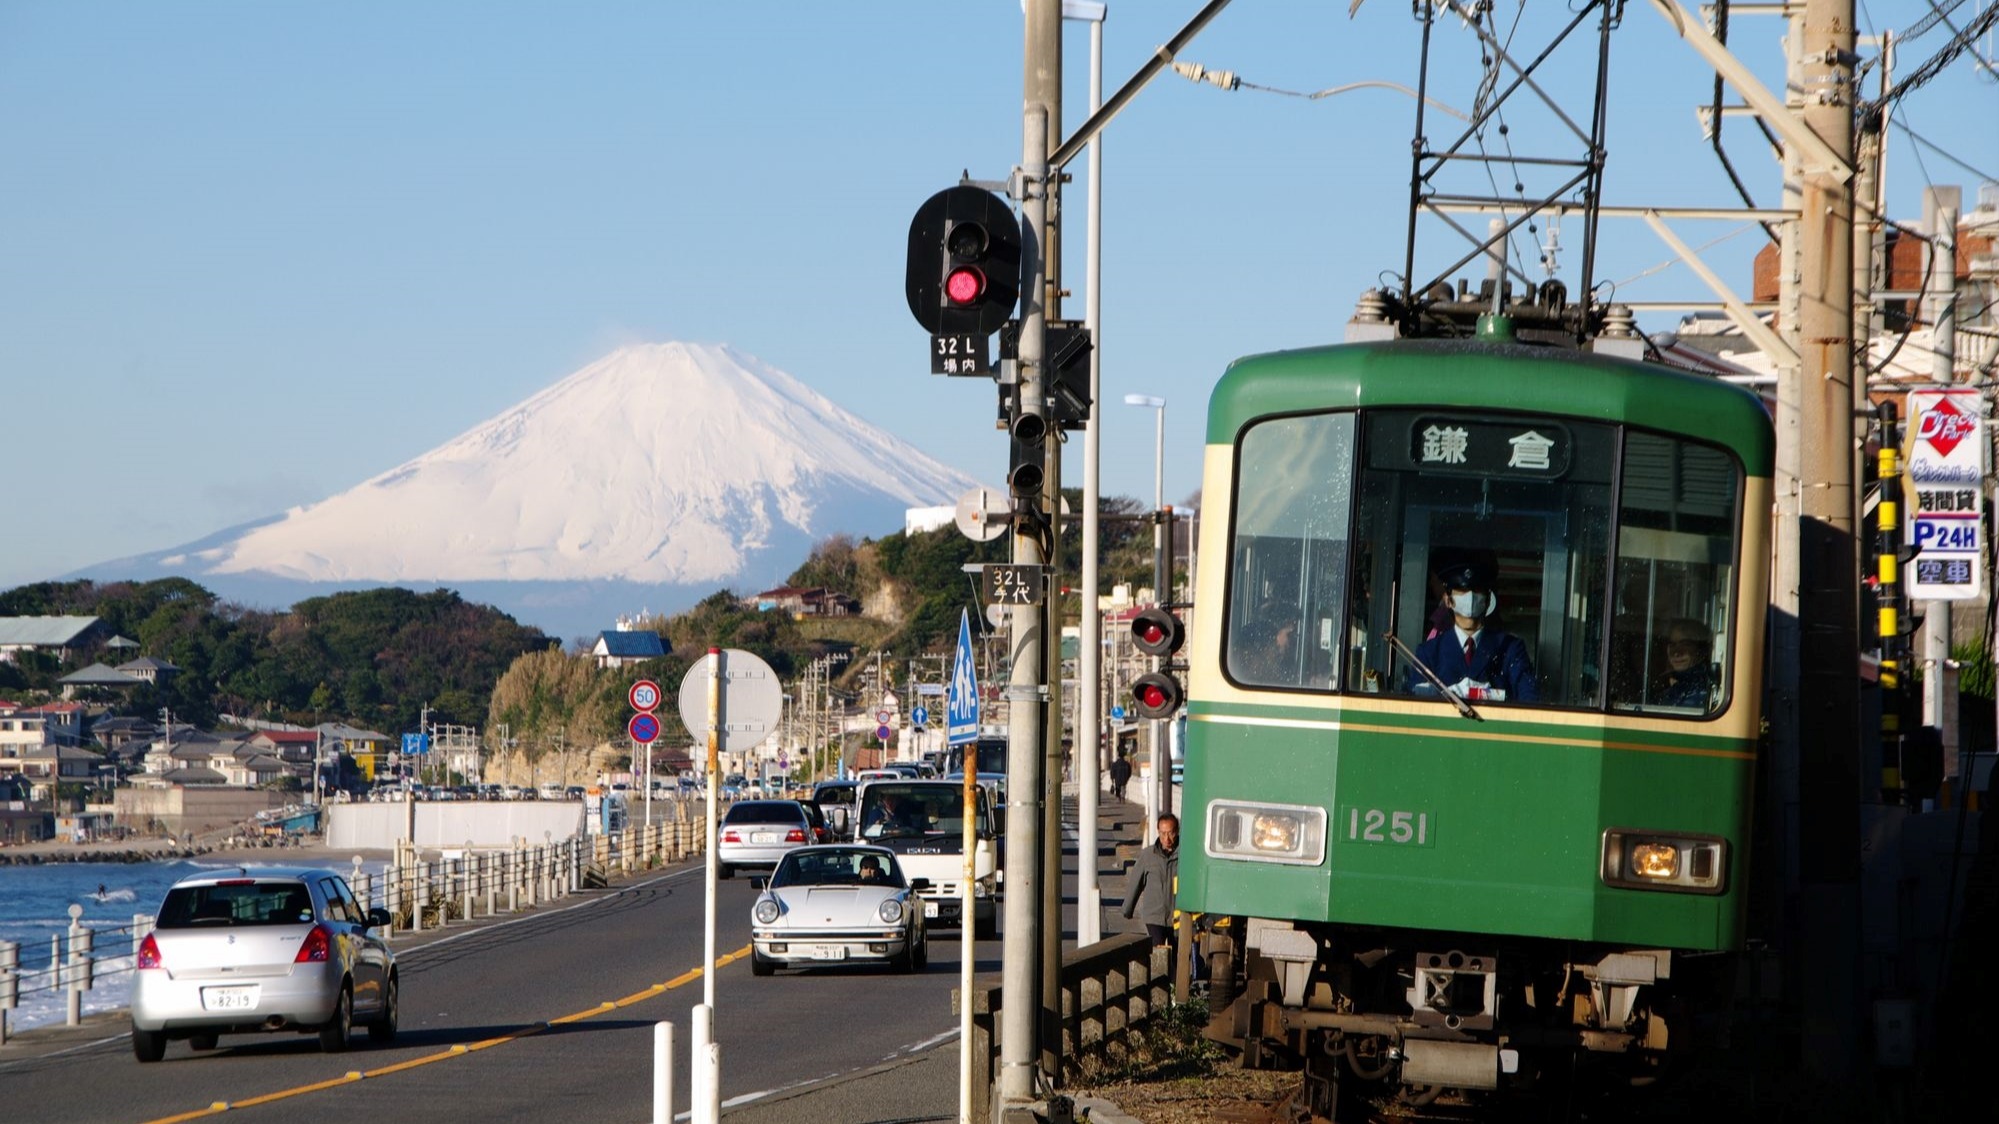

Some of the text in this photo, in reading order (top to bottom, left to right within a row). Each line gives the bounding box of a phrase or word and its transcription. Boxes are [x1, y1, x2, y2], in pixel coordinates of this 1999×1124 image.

[938, 337, 957, 355] 32
[943, 358, 976, 373] 場内
[1940, 425, 1972, 440] Park
[1422, 425, 1555, 469] 鎌倉
[1916, 489, 1976, 512] 時間貸
[1914, 521, 1976, 548] P 24H
[1918, 559, 1970, 584] 空車
[636, 688, 654, 704] 50
[1349, 808, 1427, 845] 1251
[218, 994, 250, 1008] 82-19
